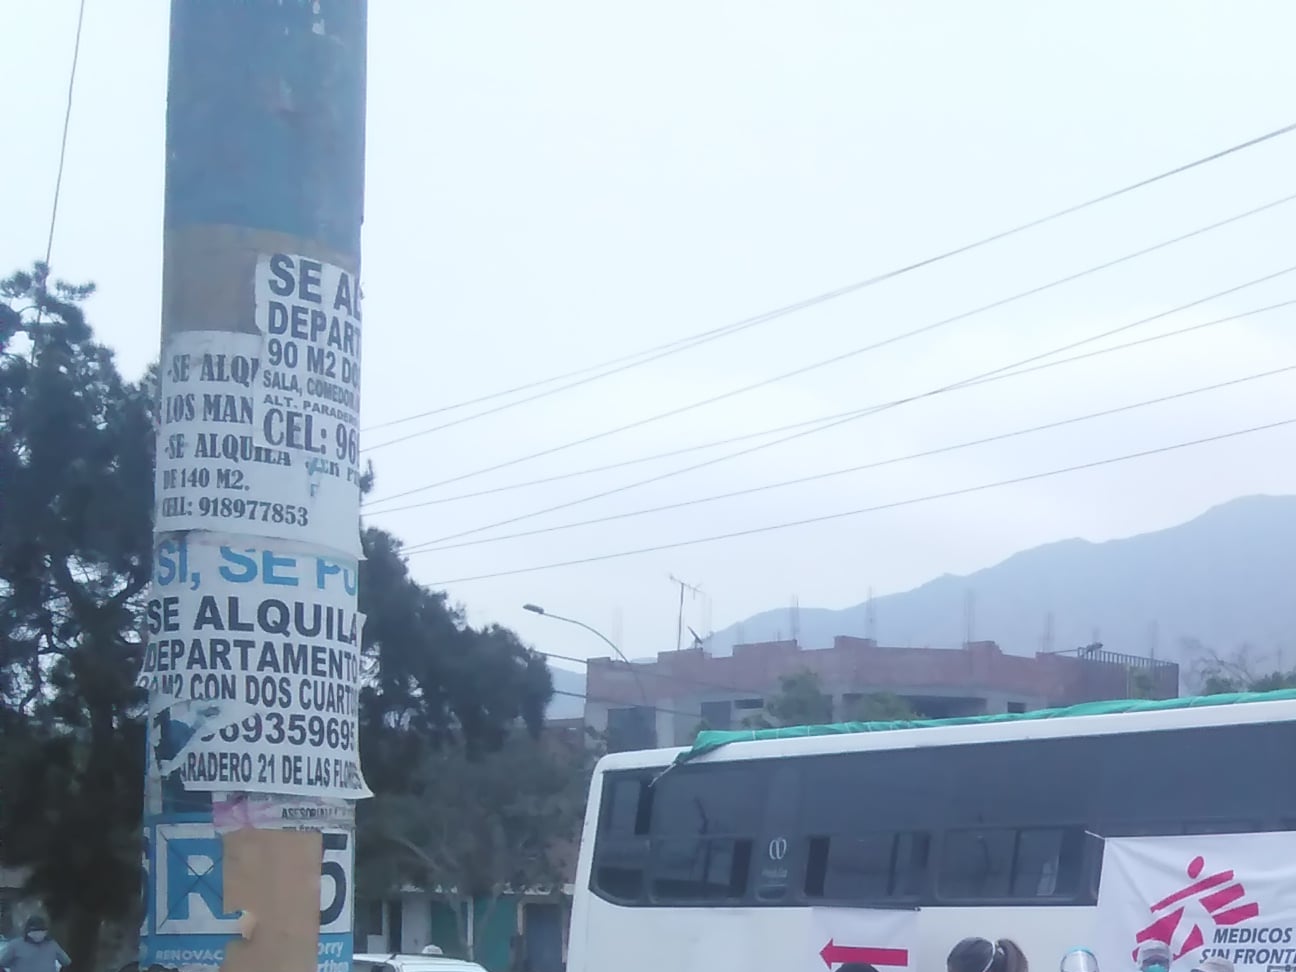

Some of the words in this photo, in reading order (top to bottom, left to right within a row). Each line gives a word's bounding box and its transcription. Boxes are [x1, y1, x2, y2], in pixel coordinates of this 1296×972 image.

[268, 253, 322, 304] SE
[268, 338, 298, 368] 90
[307, 346, 336, 379] M2
[263, 370, 302, 397] SALA,
[166, 393, 196, 424] LOS
[263, 409, 327, 455] CEL:
[181, 467, 210, 488] 140
[216, 468, 250, 491] M2.
[198, 497, 309, 527] 918977853
[218, 546, 300, 588] SE
[147, 597, 180, 635] SE
[193, 595, 358, 648] ALQUILA
[143, 638, 358, 684] DEPARTAMENTO
[190, 673, 237, 701] CON
[245, 675, 292, 709] DOS
[257, 753, 276, 783] 21
[282, 755, 302, 786] DE
[306, 756, 331, 787] LAS
[1212, 928, 1293, 944] MEDICOS
